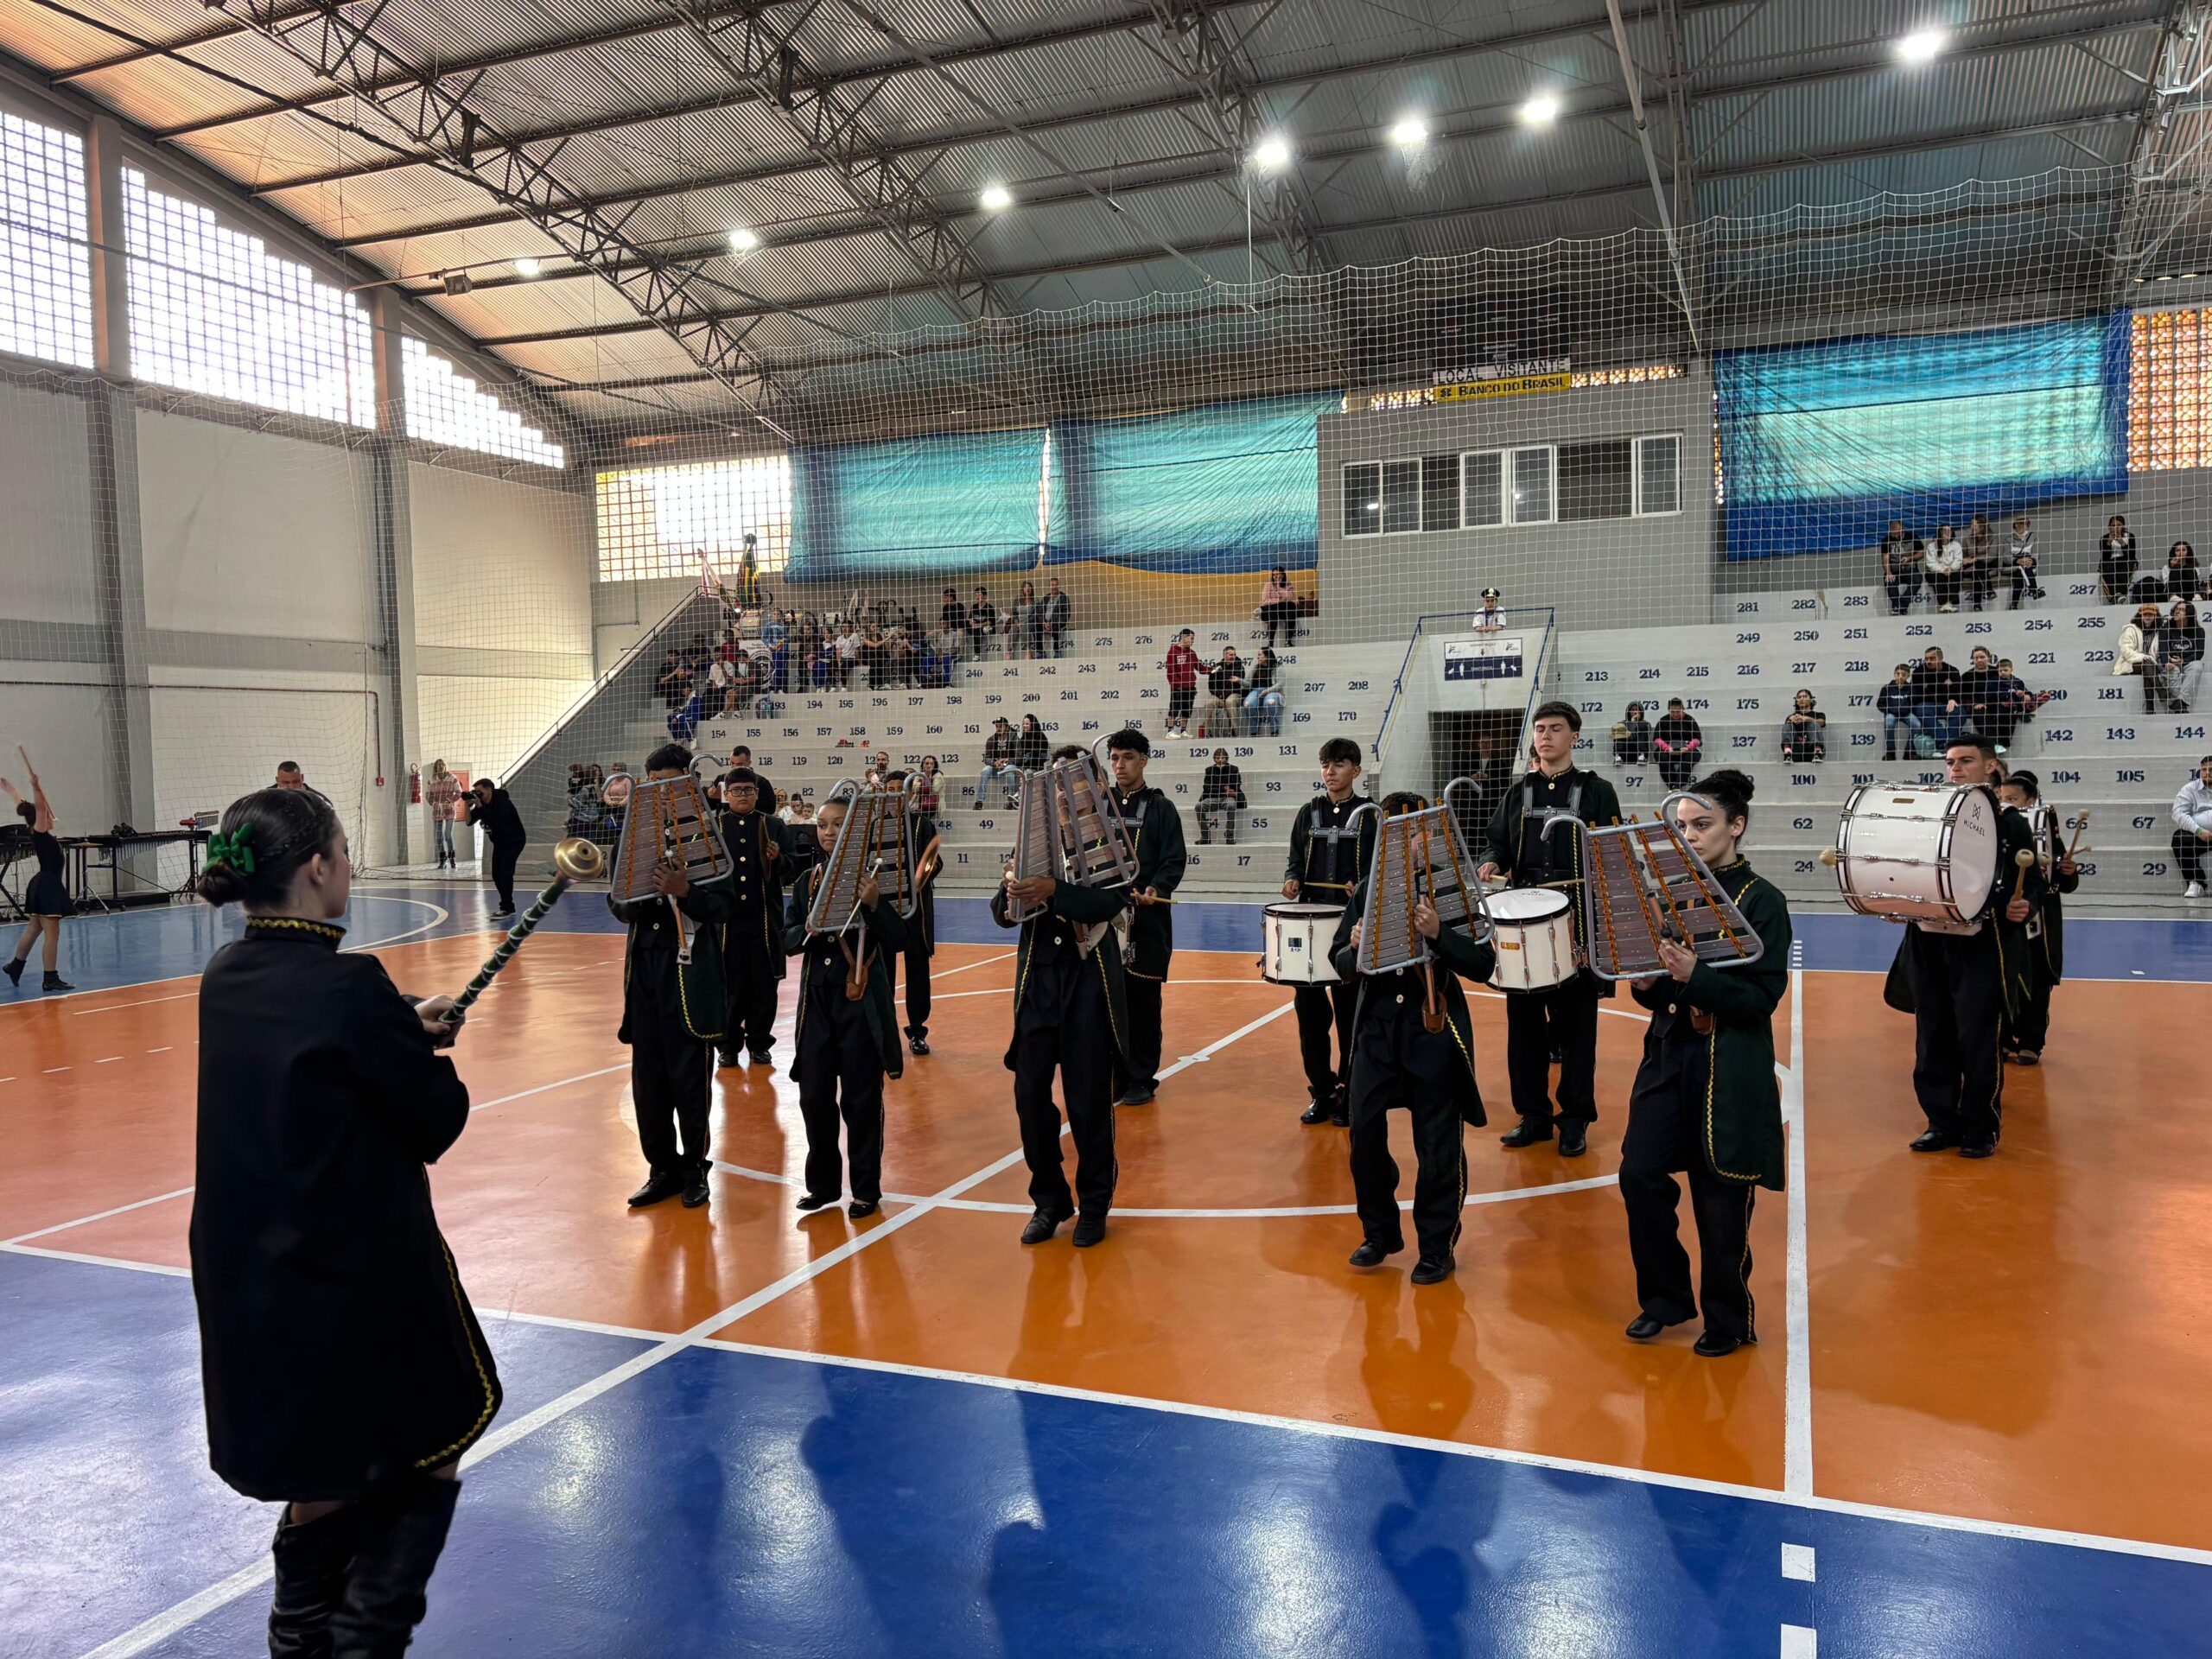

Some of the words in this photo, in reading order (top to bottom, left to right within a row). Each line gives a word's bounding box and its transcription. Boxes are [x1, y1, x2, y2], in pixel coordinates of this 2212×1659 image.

[1437, 369, 1483, 384] LOCAL
[1494, 359, 1566, 378] VISITANTE
[1459, 384, 1500, 396] BANCO
[1503, 382, 1519, 391] DO
[1522, 377, 1563, 390] BRASIL
[2069, 584, 2097, 595] 287
[1792, 599, 1816, 610] 282
[1843, 596, 1869, 606] 283
[1737, 602, 1759, 613] 281
[1966, 622, 1992, 633] 253
[2024, 620, 2053, 631] 254
[2078, 617, 2105, 628] 255
[1250, 630, 1269, 639] 279
[1793, 630, 1819, 641] 250
[1843, 628, 1868, 639] 251
[1906, 625, 1933, 636] 252
[1135, 636, 1153, 645] 276
[1211, 632, 1230, 641] 278
[1736, 632, 1760, 643] 249
[1095, 637, 1113, 647] 275
[1277, 655, 1297, 664] 248
[2028, 652, 2056, 664] 221
[2085, 650, 2114, 662] 223
[1078, 664, 1096, 673] 243
[1119, 662, 1138, 671] 244
[1157, 661, 1167, 670] 24
[1792, 662, 1816, 674] 217
[1845, 661, 1869, 672] 218
[1908, 658, 1925, 669] 21
[966, 670, 983, 678] 240
[1003, 668, 1018, 676] 241
[1039, 666, 1056, 674] 242
[1639, 668, 1661, 679] 214
[1686, 666, 1709, 677] 215
[1737, 664, 1760, 675] 216
[1585, 671, 1608, 682] 213
[1304, 683, 1326, 693] 207
[1348, 681, 1369, 690] 208
[1022, 693, 1040, 702] 200
[1060, 691, 1078, 701] 201
[1100, 690, 1119, 700] 202
[1140, 689, 1159, 698] 203
[2097, 688, 2124, 699] 181
[807, 700, 823, 709] 194
[839, 700, 854, 708] 195
[872, 698, 888, 706] 196
[908, 697, 924, 706] 197
[947, 696, 962, 705] 198
[985, 695, 1002, 704] 199
[1686, 699, 1710, 709] 174
[1736, 698, 1760, 709] 175
[1848, 695, 1874, 707] 177
[1581, 702, 1603, 712] 172
[1293, 712, 1311, 722] 169
[1338, 712, 1357, 721] 170
[1042, 722, 1059, 731] 163
[1081, 721, 1099, 730] 164
[1124, 719, 1142, 729] 165
[711, 730, 726, 739] 154
[747, 729, 761, 737] 155
[782, 728, 799, 737] 156
[817, 727, 833, 735] 157
[850, 726, 866, 735] 158
[887, 726, 903, 735] 159
[926, 725, 943, 734] 160
[964, 725, 980, 734] 161
[2106, 728, 2136, 740] 143
[2175, 727, 2206, 739] 144
[1850, 734, 1876, 746] 139
[2045, 730, 2074, 741] 142
[1732, 736, 1756, 747] 137
[1189, 748, 1209, 758] 129
[1234, 747, 1253, 756] 130
[1279, 745, 1298, 756] 131
[758, 757, 772, 766] 118
[792, 756, 807, 765] 119
[827, 756, 843, 765] 120
[865, 756, 876, 765] 12
[904, 755, 921, 764] 122
[941, 754, 959, 763] 123
[1791, 774, 1817, 785] 100
[1852, 774, 1874, 785] 101
[1918, 772, 1944, 785] 102
[2051, 771, 2081, 783] 104
[2116, 770, 2145, 782] 105
[1266, 782, 1281, 792] 93
[1626, 776, 1644, 788] 97
[802, 788, 814, 797] 82
[842, 788, 854, 796] 83
[962, 787, 975, 796] 86
[1176, 784, 1189, 794] 91
[938, 821, 952, 830] 48
[979, 820, 994, 829] 49
[1252, 818, 1268, 828] 55
[1793, 818, 1813, 830] 62
[1964, 820, 1985, 836] MICHAEL
[2133, 817, 2155, 829] 67
[957, 853, 969, 863] 11
[999, 854, 1011, 863] 12
[1187, 855, 1200, 865] 16
[1237, 856, 1251, 866] 17
[1794, 861, 1815, 872] 24
[2142, 863, 2167, 876] 29
